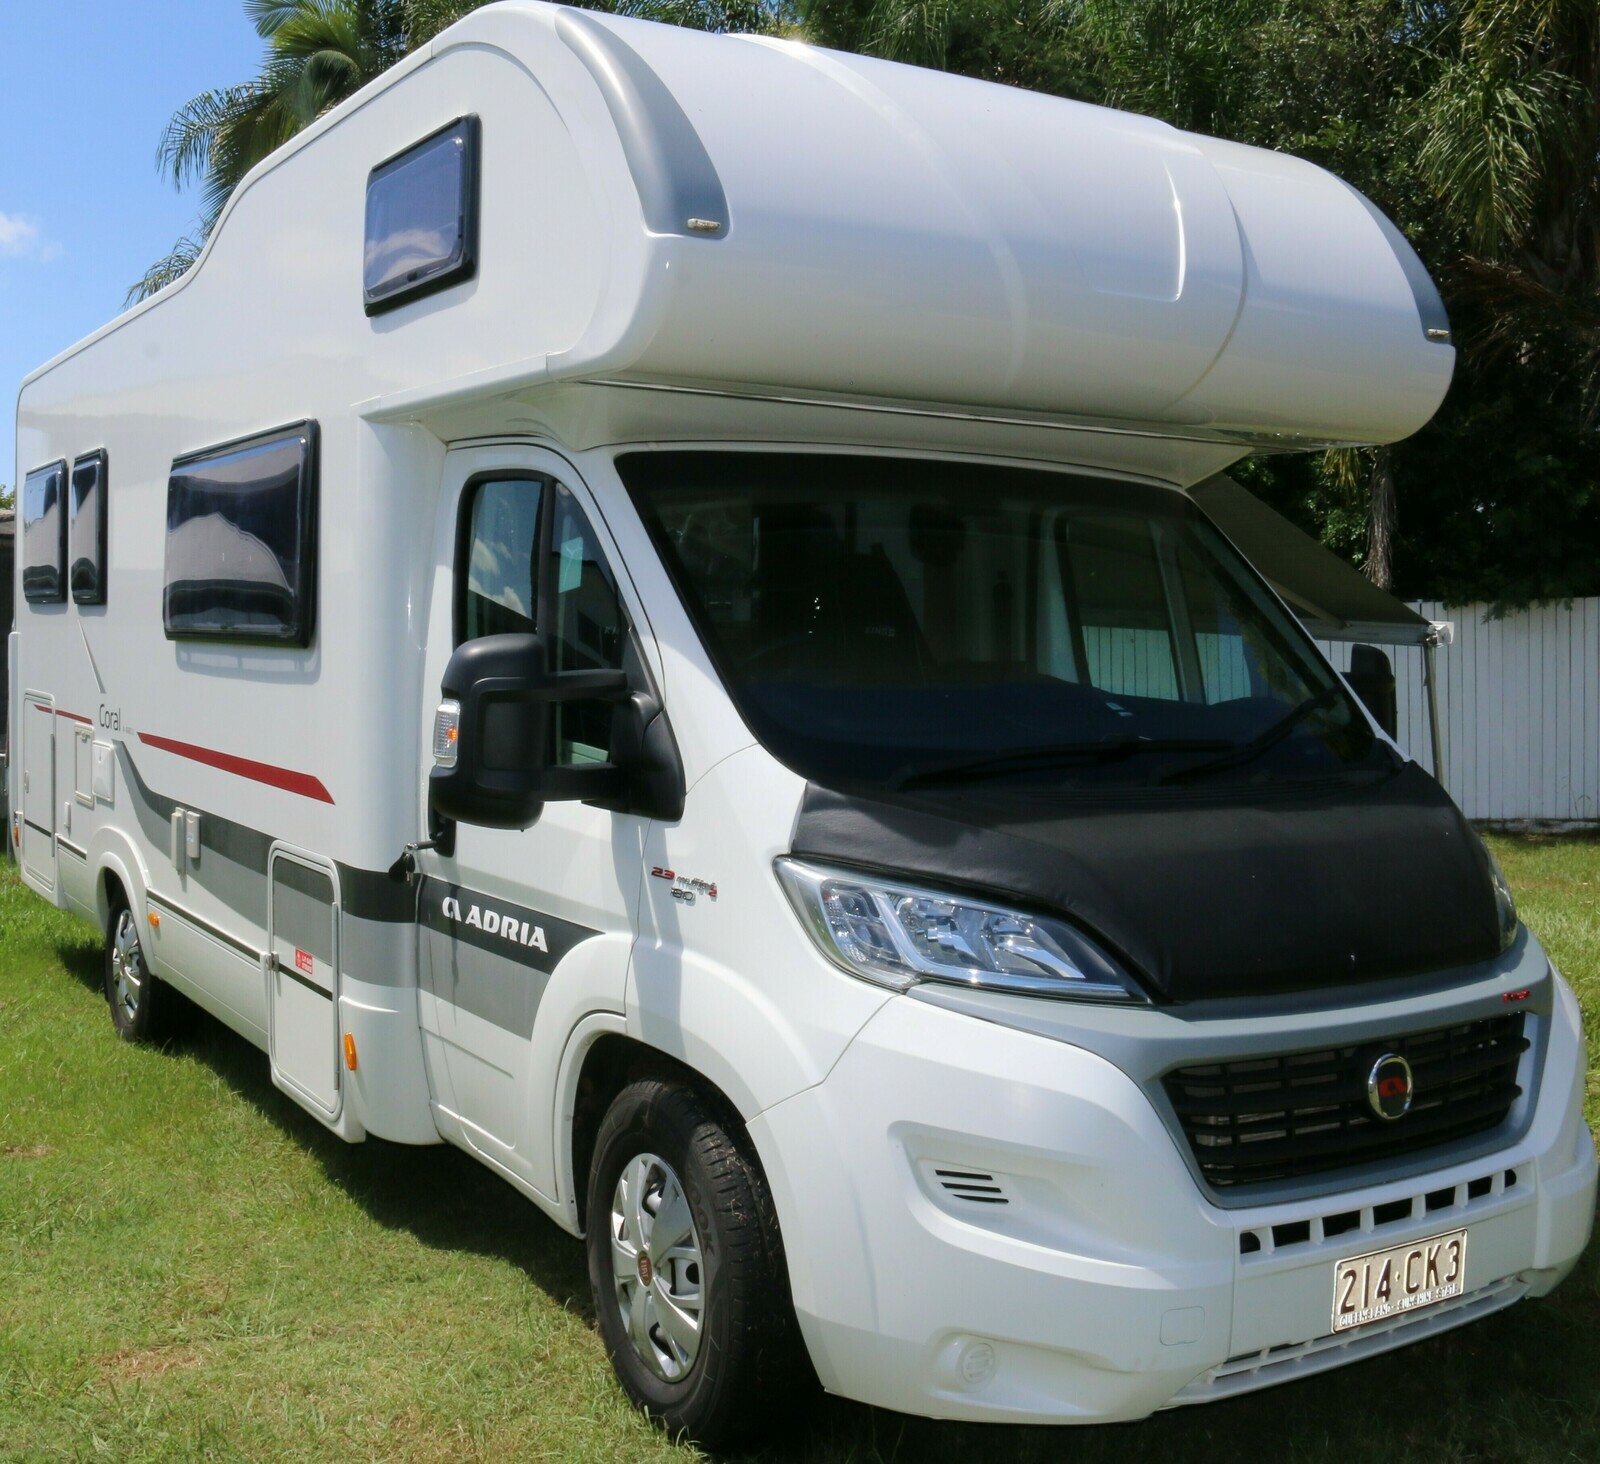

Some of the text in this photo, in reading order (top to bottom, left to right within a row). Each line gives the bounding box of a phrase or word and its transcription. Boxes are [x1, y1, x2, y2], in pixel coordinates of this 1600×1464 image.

[99, 703, 121, 732] Coral
[465, 904, 549, 954] ADRIA
[640, 1259, 649, 1278] FIAT
